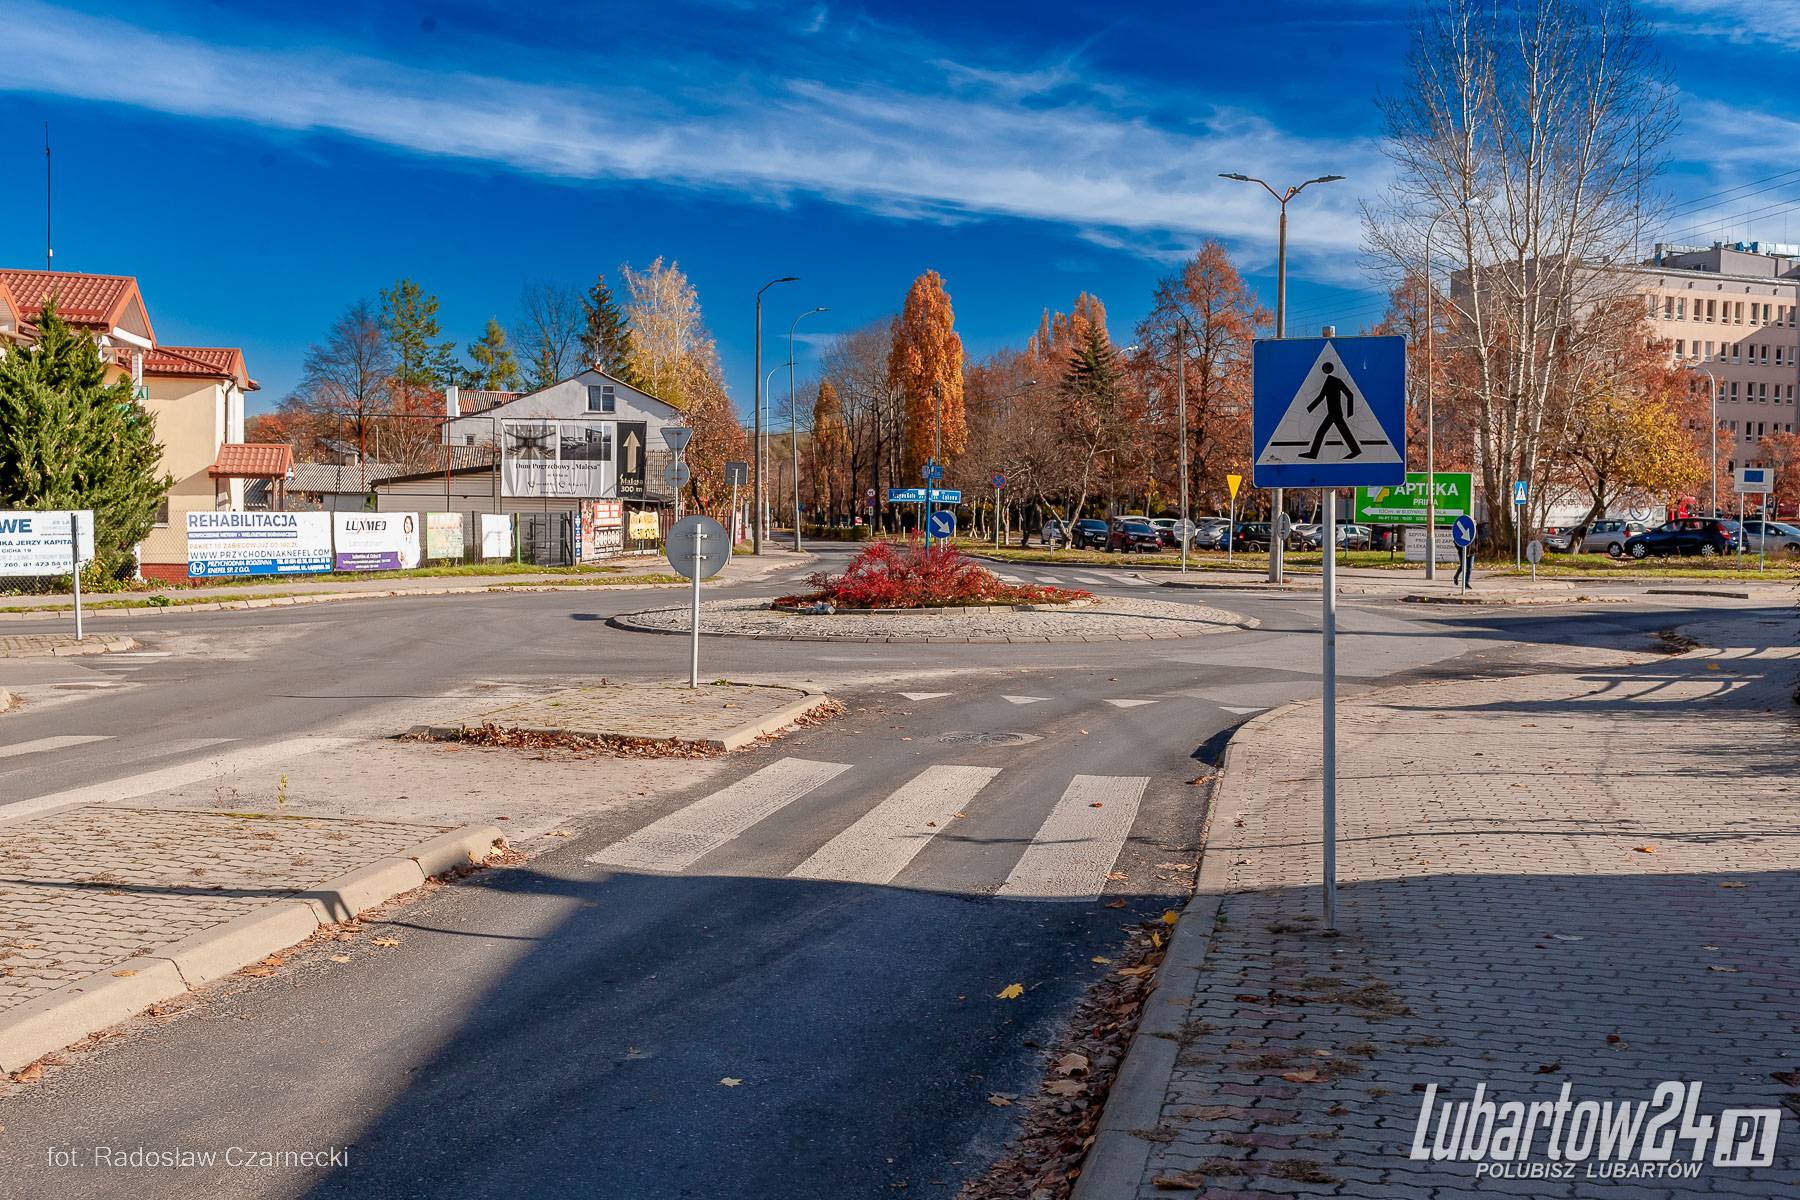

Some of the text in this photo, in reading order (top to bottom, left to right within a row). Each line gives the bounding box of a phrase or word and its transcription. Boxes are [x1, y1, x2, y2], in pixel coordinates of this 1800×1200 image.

[532, 463, 570, 471] Pogrzebowy
[620, 485, 635, 493] 300
[1394, 482, 1459, 496] APTEKA
[189, 515, 297, 527] REHABILITACJA
[345, 520, 387, 532] LUXMED
[190, 549, 330, 559] WWW.PRZYCHODNIAKNEFEL.COM
